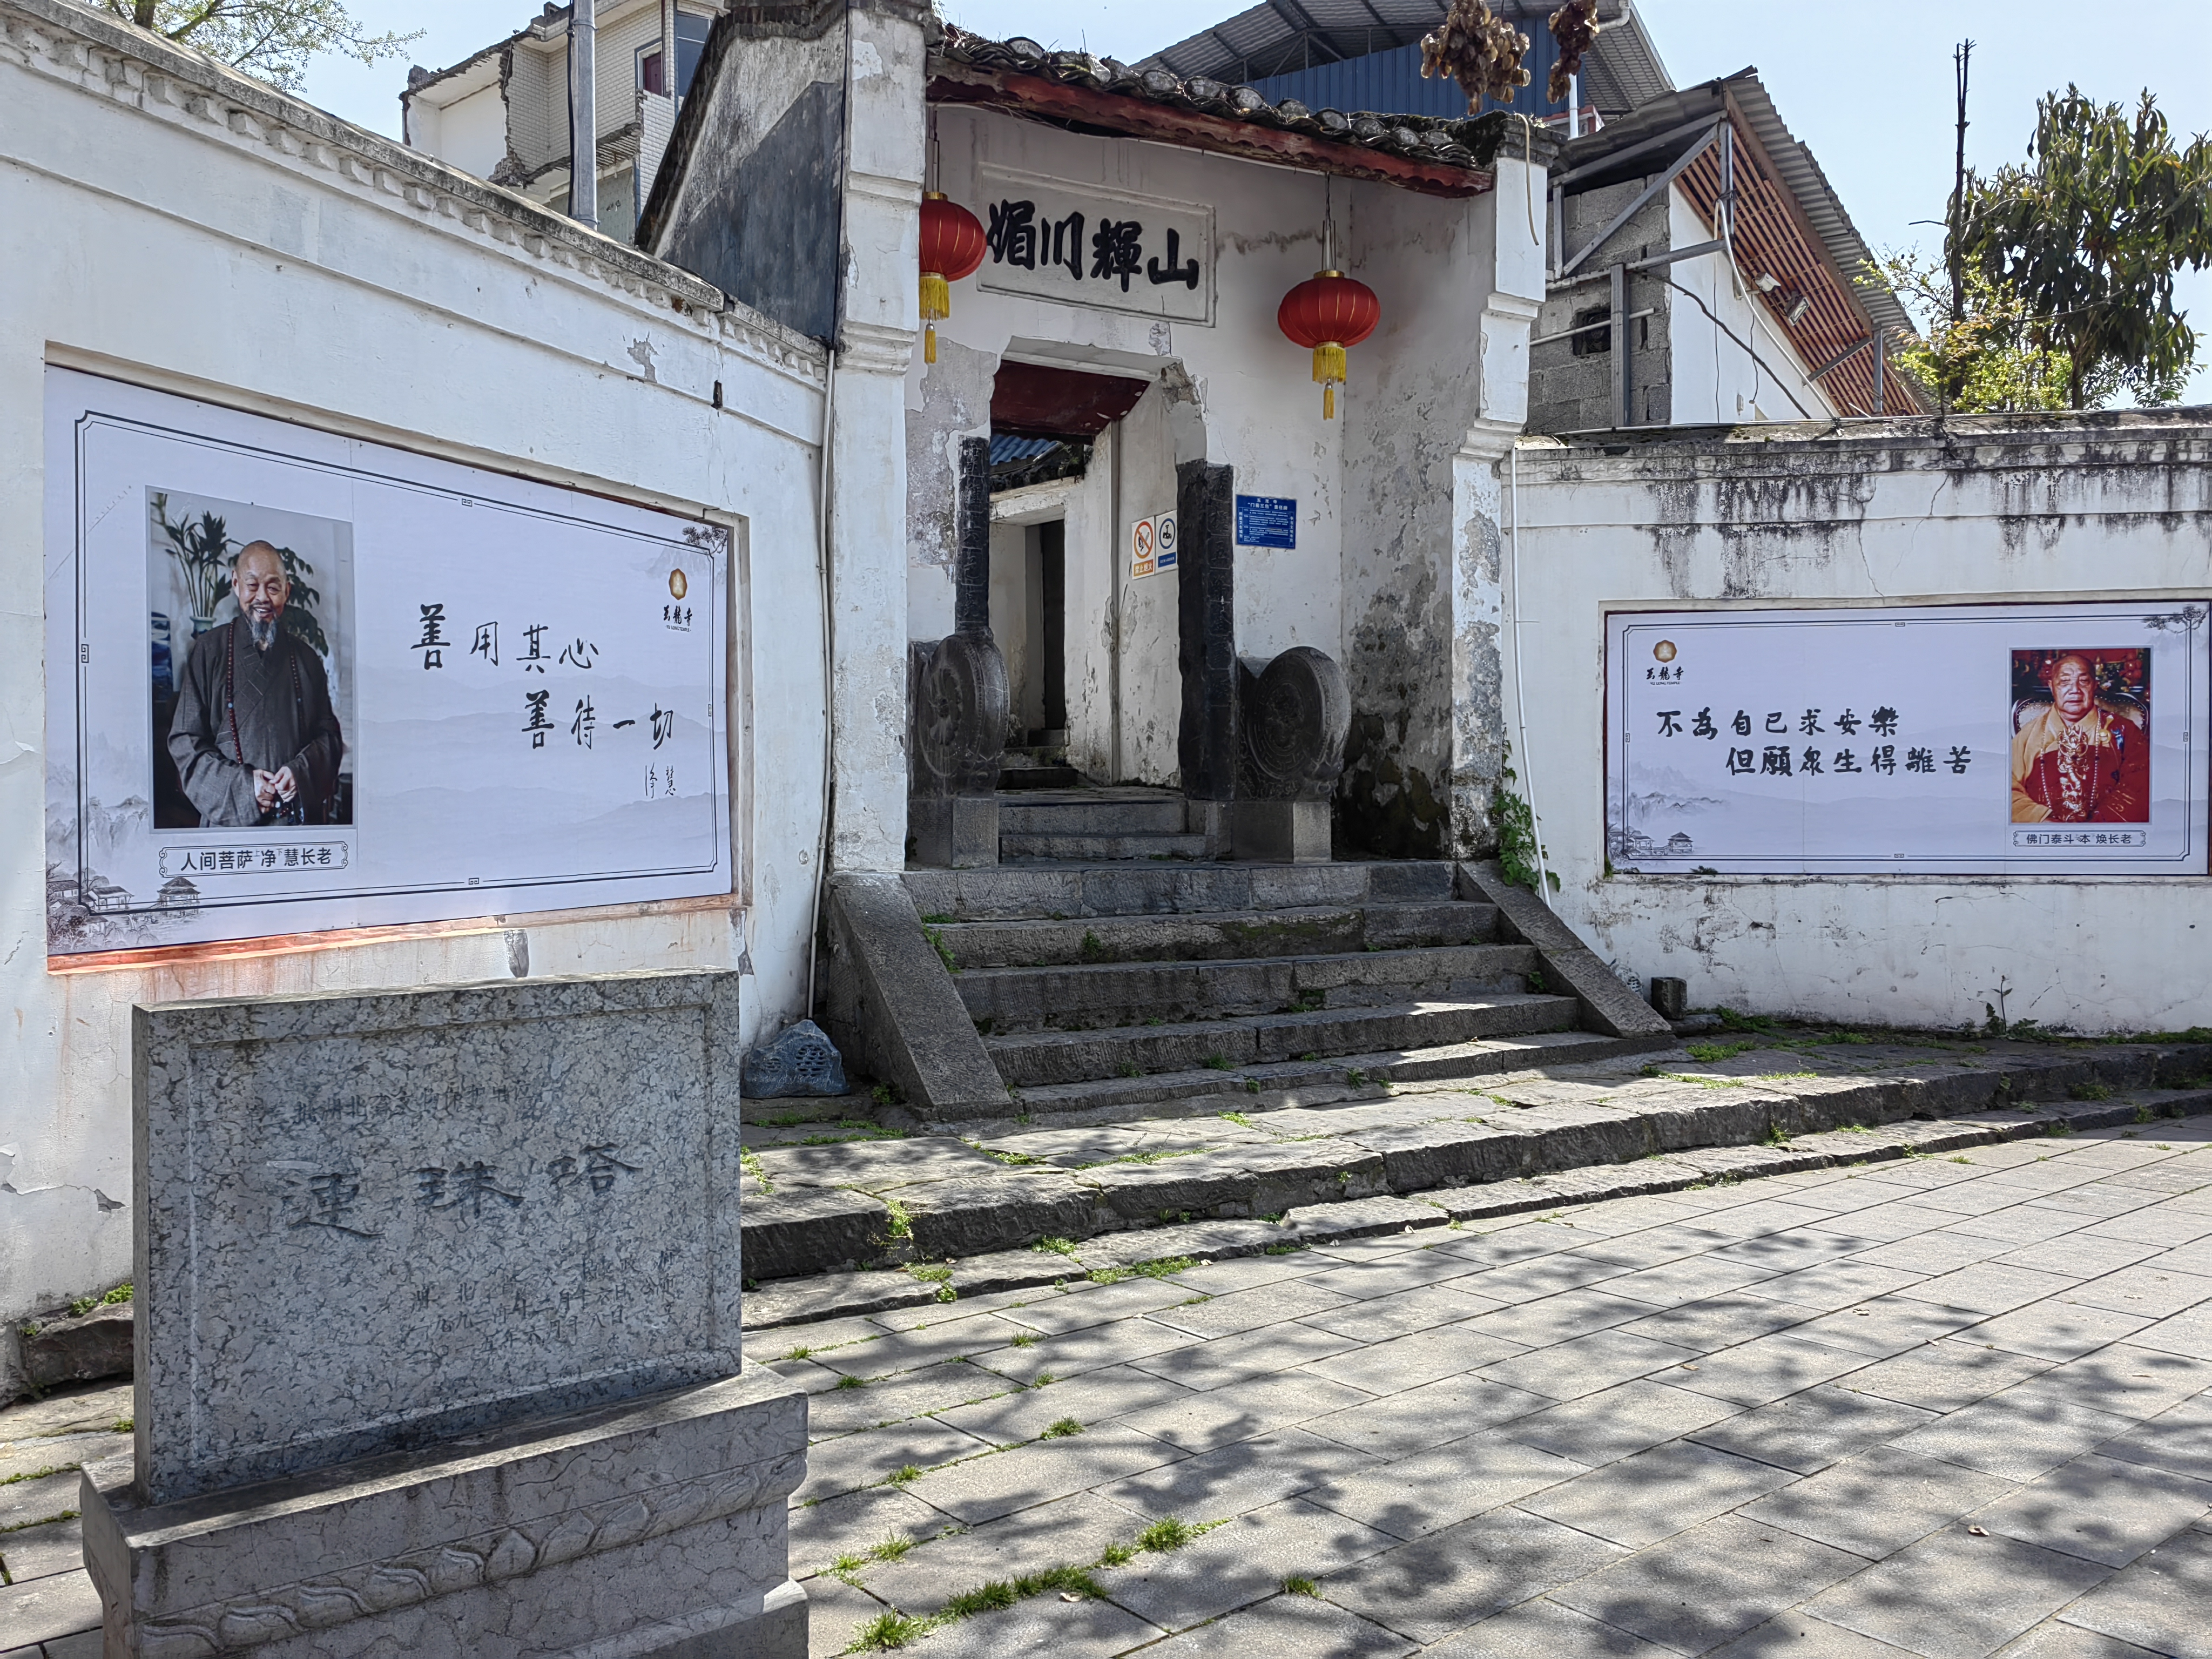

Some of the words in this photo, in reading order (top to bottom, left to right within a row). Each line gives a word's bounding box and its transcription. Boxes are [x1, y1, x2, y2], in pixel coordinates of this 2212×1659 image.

[411, 603, 599, 673] 善用其心
[521, 689, 673, 750] 善待一切
